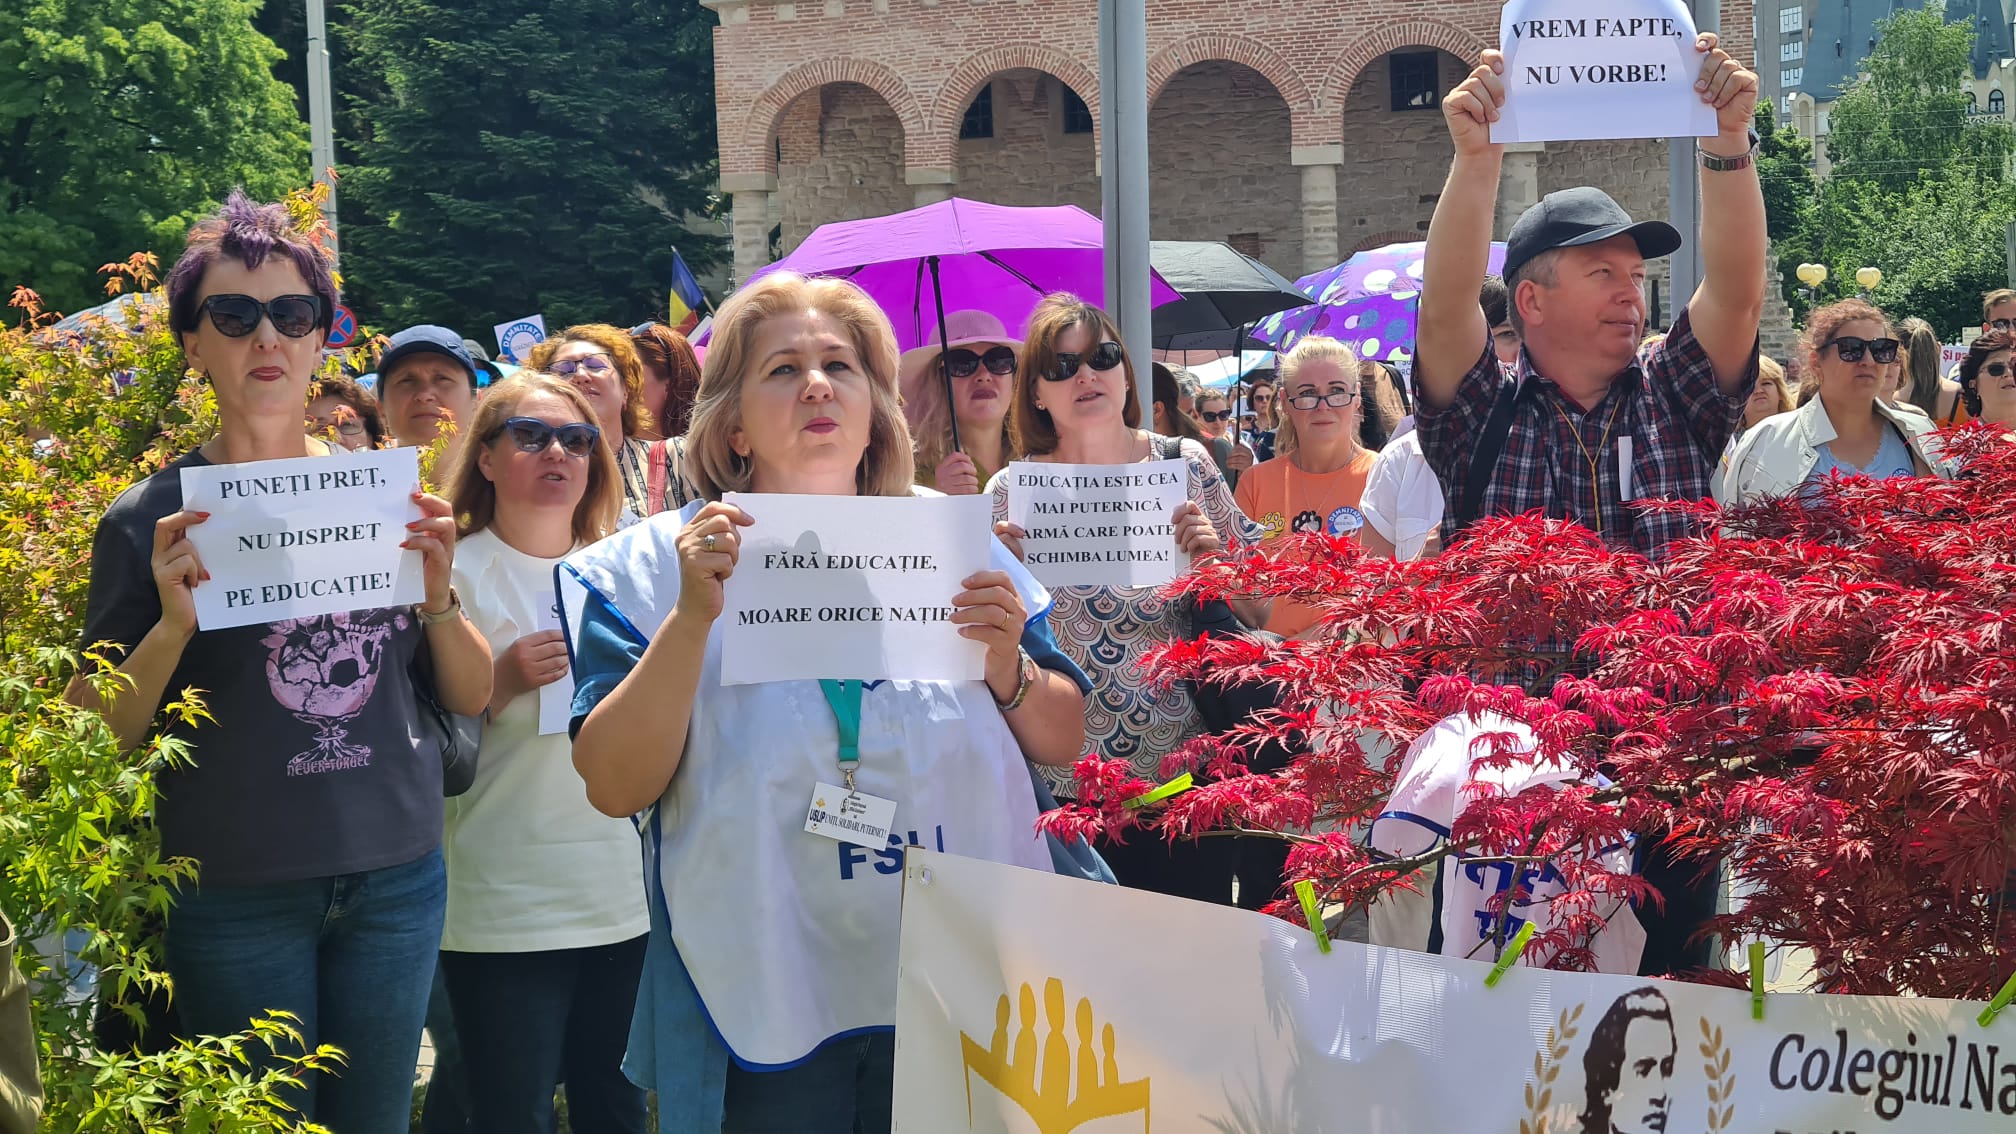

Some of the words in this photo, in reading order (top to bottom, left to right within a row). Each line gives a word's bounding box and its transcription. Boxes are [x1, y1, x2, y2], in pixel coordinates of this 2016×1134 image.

[1512, 19, 1586, 39] VREM
[1595, 18, 1682, 39] FAPTE,
[1526, 66, 1560, 85] NU
[1568, 64, 1666, 84] VORBE!
[219, 474, 311, 499] PUNEȚI
[319, 467, 386, 490] PREȚ,
[1018, 474, 1100, 491] EDUCAȚIA
[1104, 475, 1144, 488] ESTE
[1148, 472, 1178, 486] CEA
[1033, 502, 1065, 514] MAI
[1070, 497, 1163, 514] PUTERNICĂ
[238, 533, 272, 552] NU
[280, 522, 382, 547] DISPREȚ
[1023, 525, 1071, 539] ARMĂ
[1074, 526, 1118, 538] CARE
[1123, 524, 1175, 537] POATE
[764, 551, 820, 569] FĂRĂ
[827, 555, 938, 573] EDUCAȚIE,
[1027, 551, 1102, 565] SCHIMBA
[1105, 550, 1169, 562] LUMEA!
[224, 588, 255, 608] PE
[262, 572, 391, 604] EDUCAȚIE!
[738, 608, 812, 626] MOARE
[818, 607, 883, 622] ORICE
[1769, 1028, 1957, 1121] Colegiul
[1959, 1043, 2016, 1116] Na
